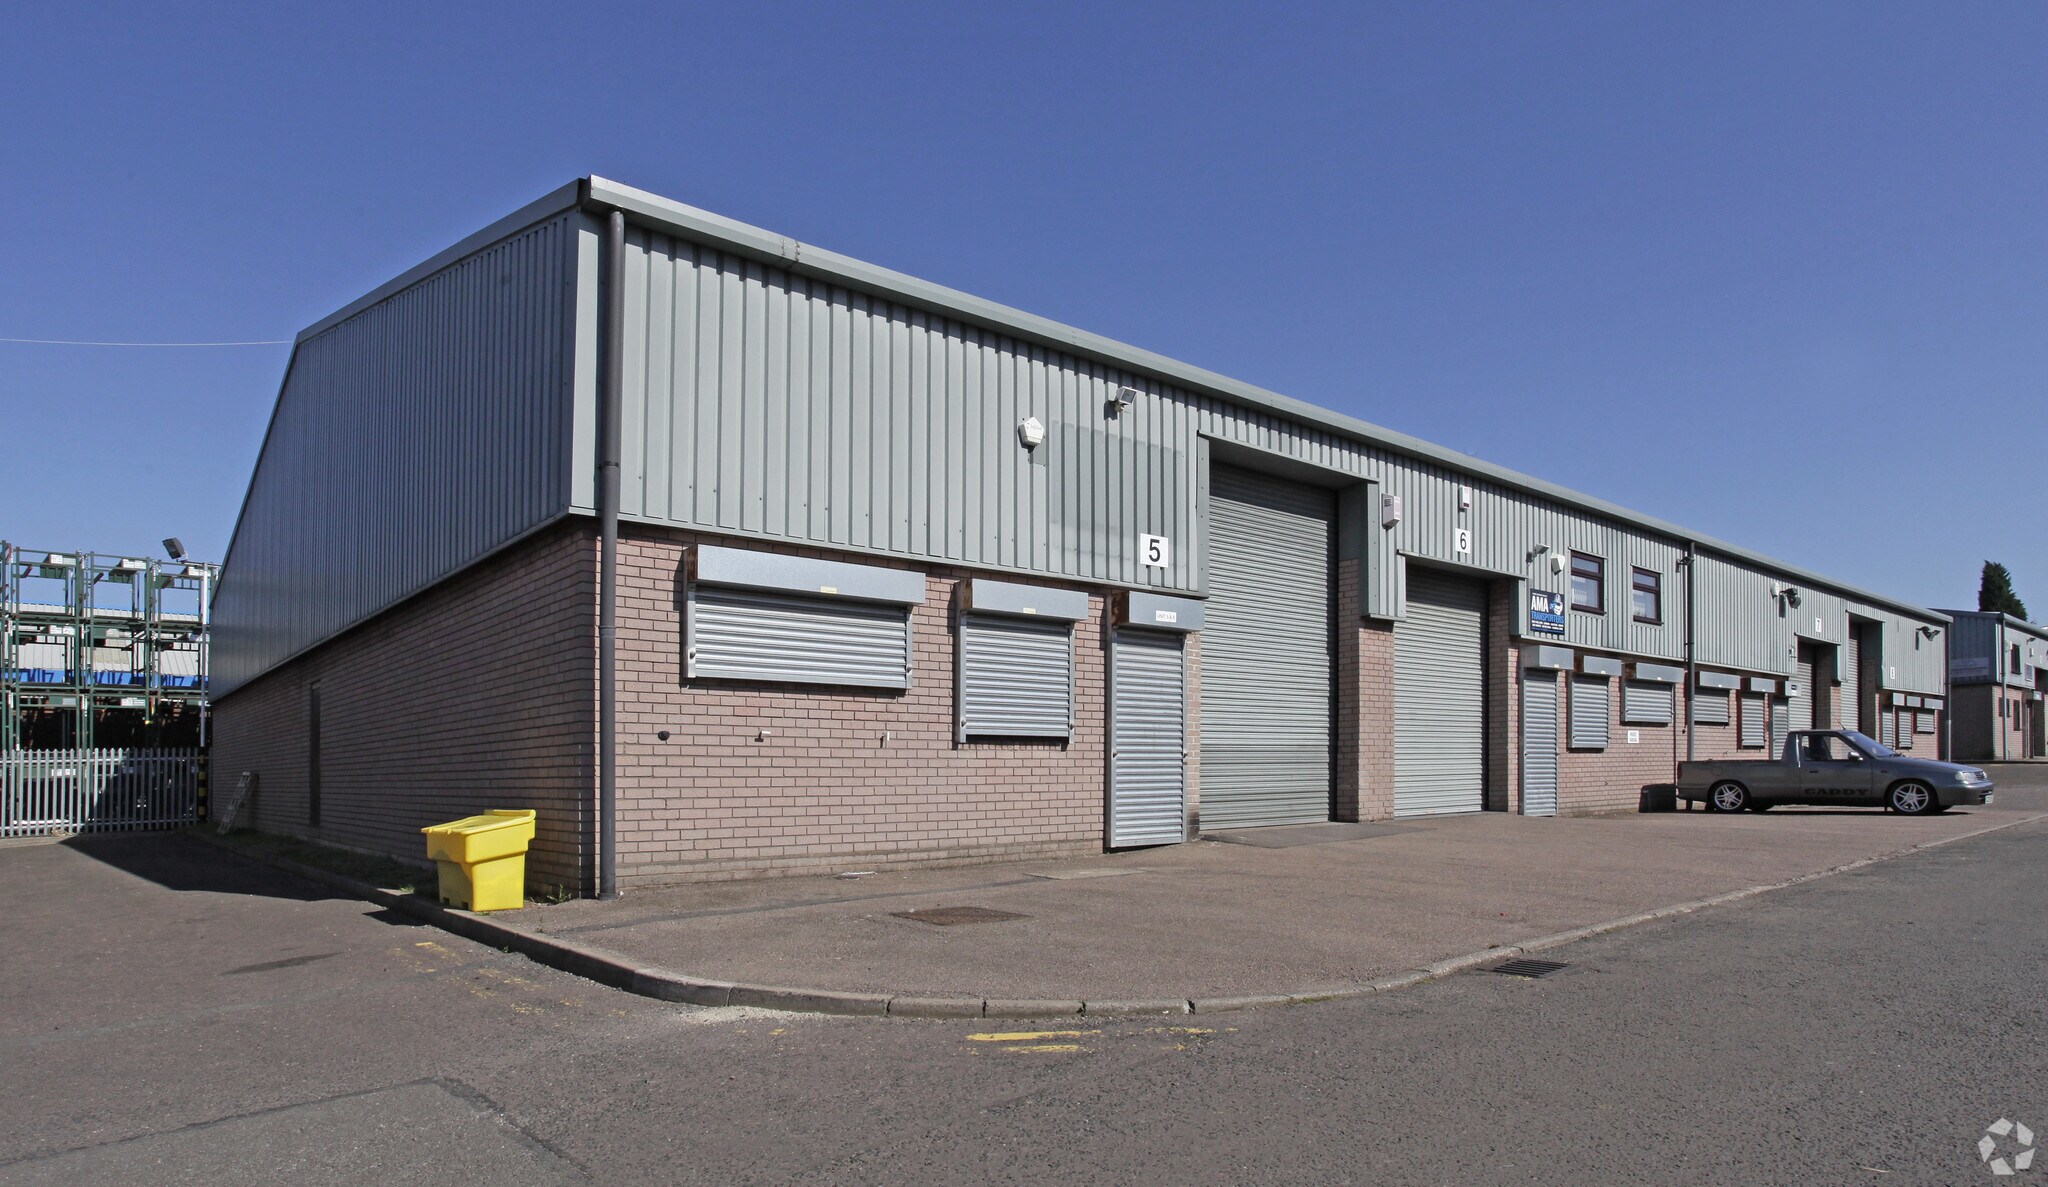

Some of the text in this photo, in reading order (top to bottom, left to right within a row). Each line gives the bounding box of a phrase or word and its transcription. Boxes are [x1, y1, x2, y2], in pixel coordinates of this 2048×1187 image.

[1460, 532, 1467, 550] 6
[1148, 538, 1161, 562] 5
[1531, 596, 1549, 613] AMA
[1804, 788, 1869, 796] CADDY
